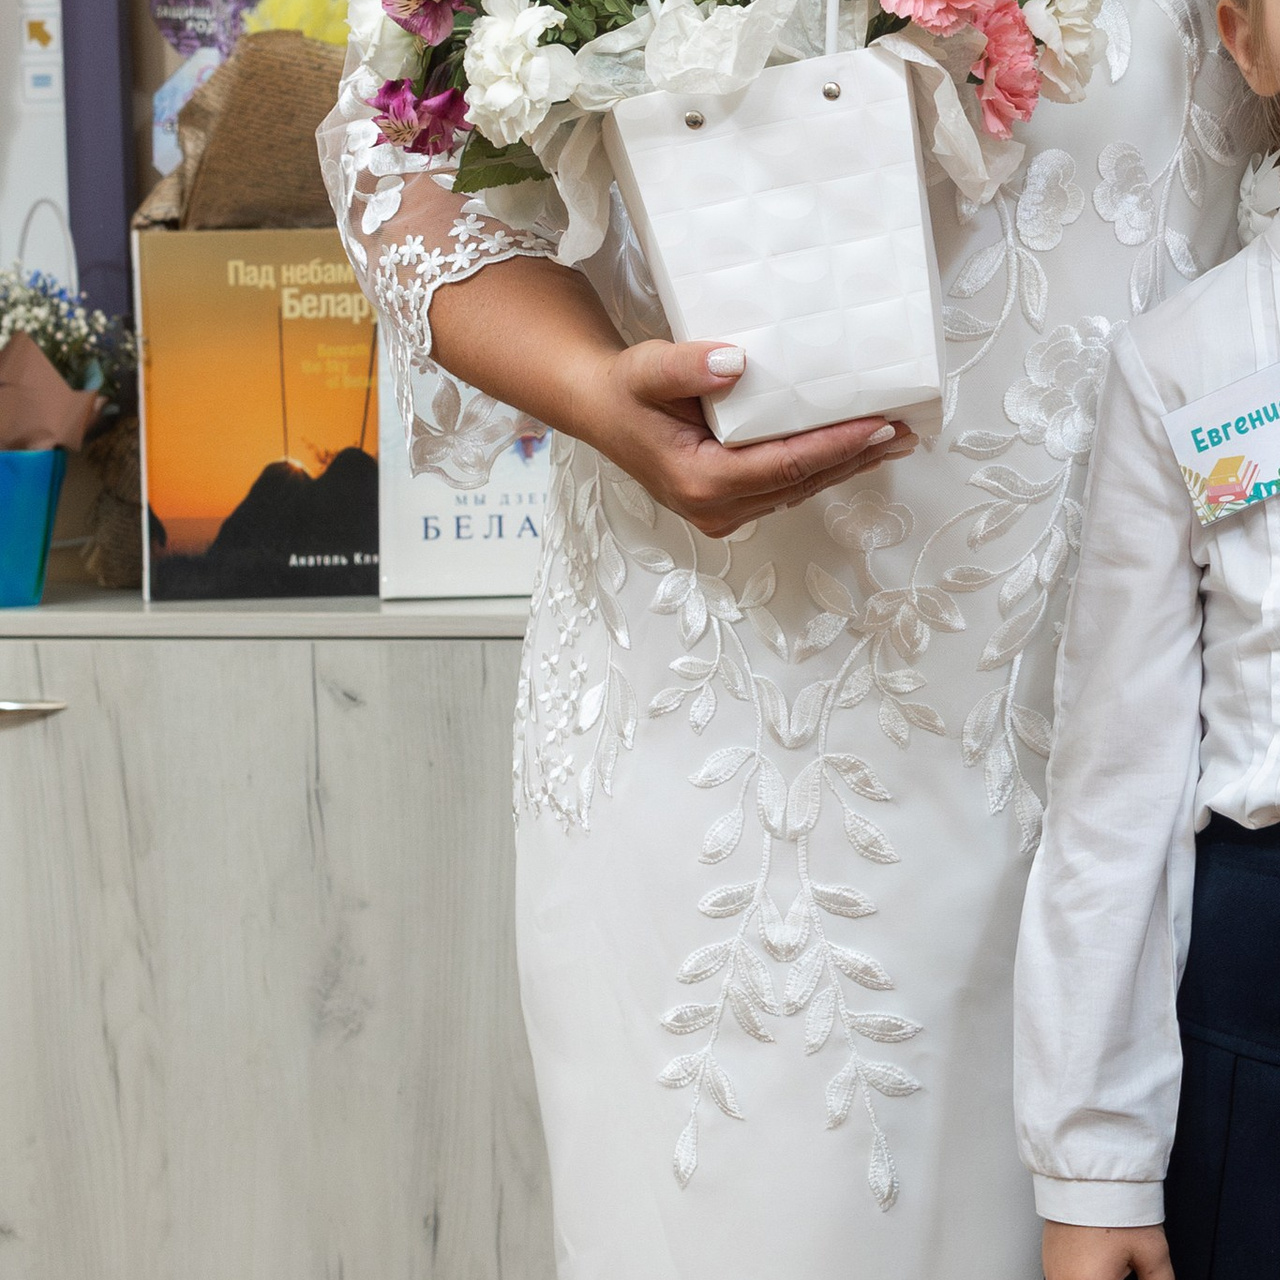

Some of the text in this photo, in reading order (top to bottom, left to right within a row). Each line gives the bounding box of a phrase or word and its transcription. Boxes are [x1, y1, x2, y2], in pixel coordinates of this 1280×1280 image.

[227, 258, 355, 290] Пад небам
[454, 493, 547, 506] МЫ ДЗЕ
[422, 514, 540, 541] БЕЛА
[288, 553, 349, 568] Анатоль
